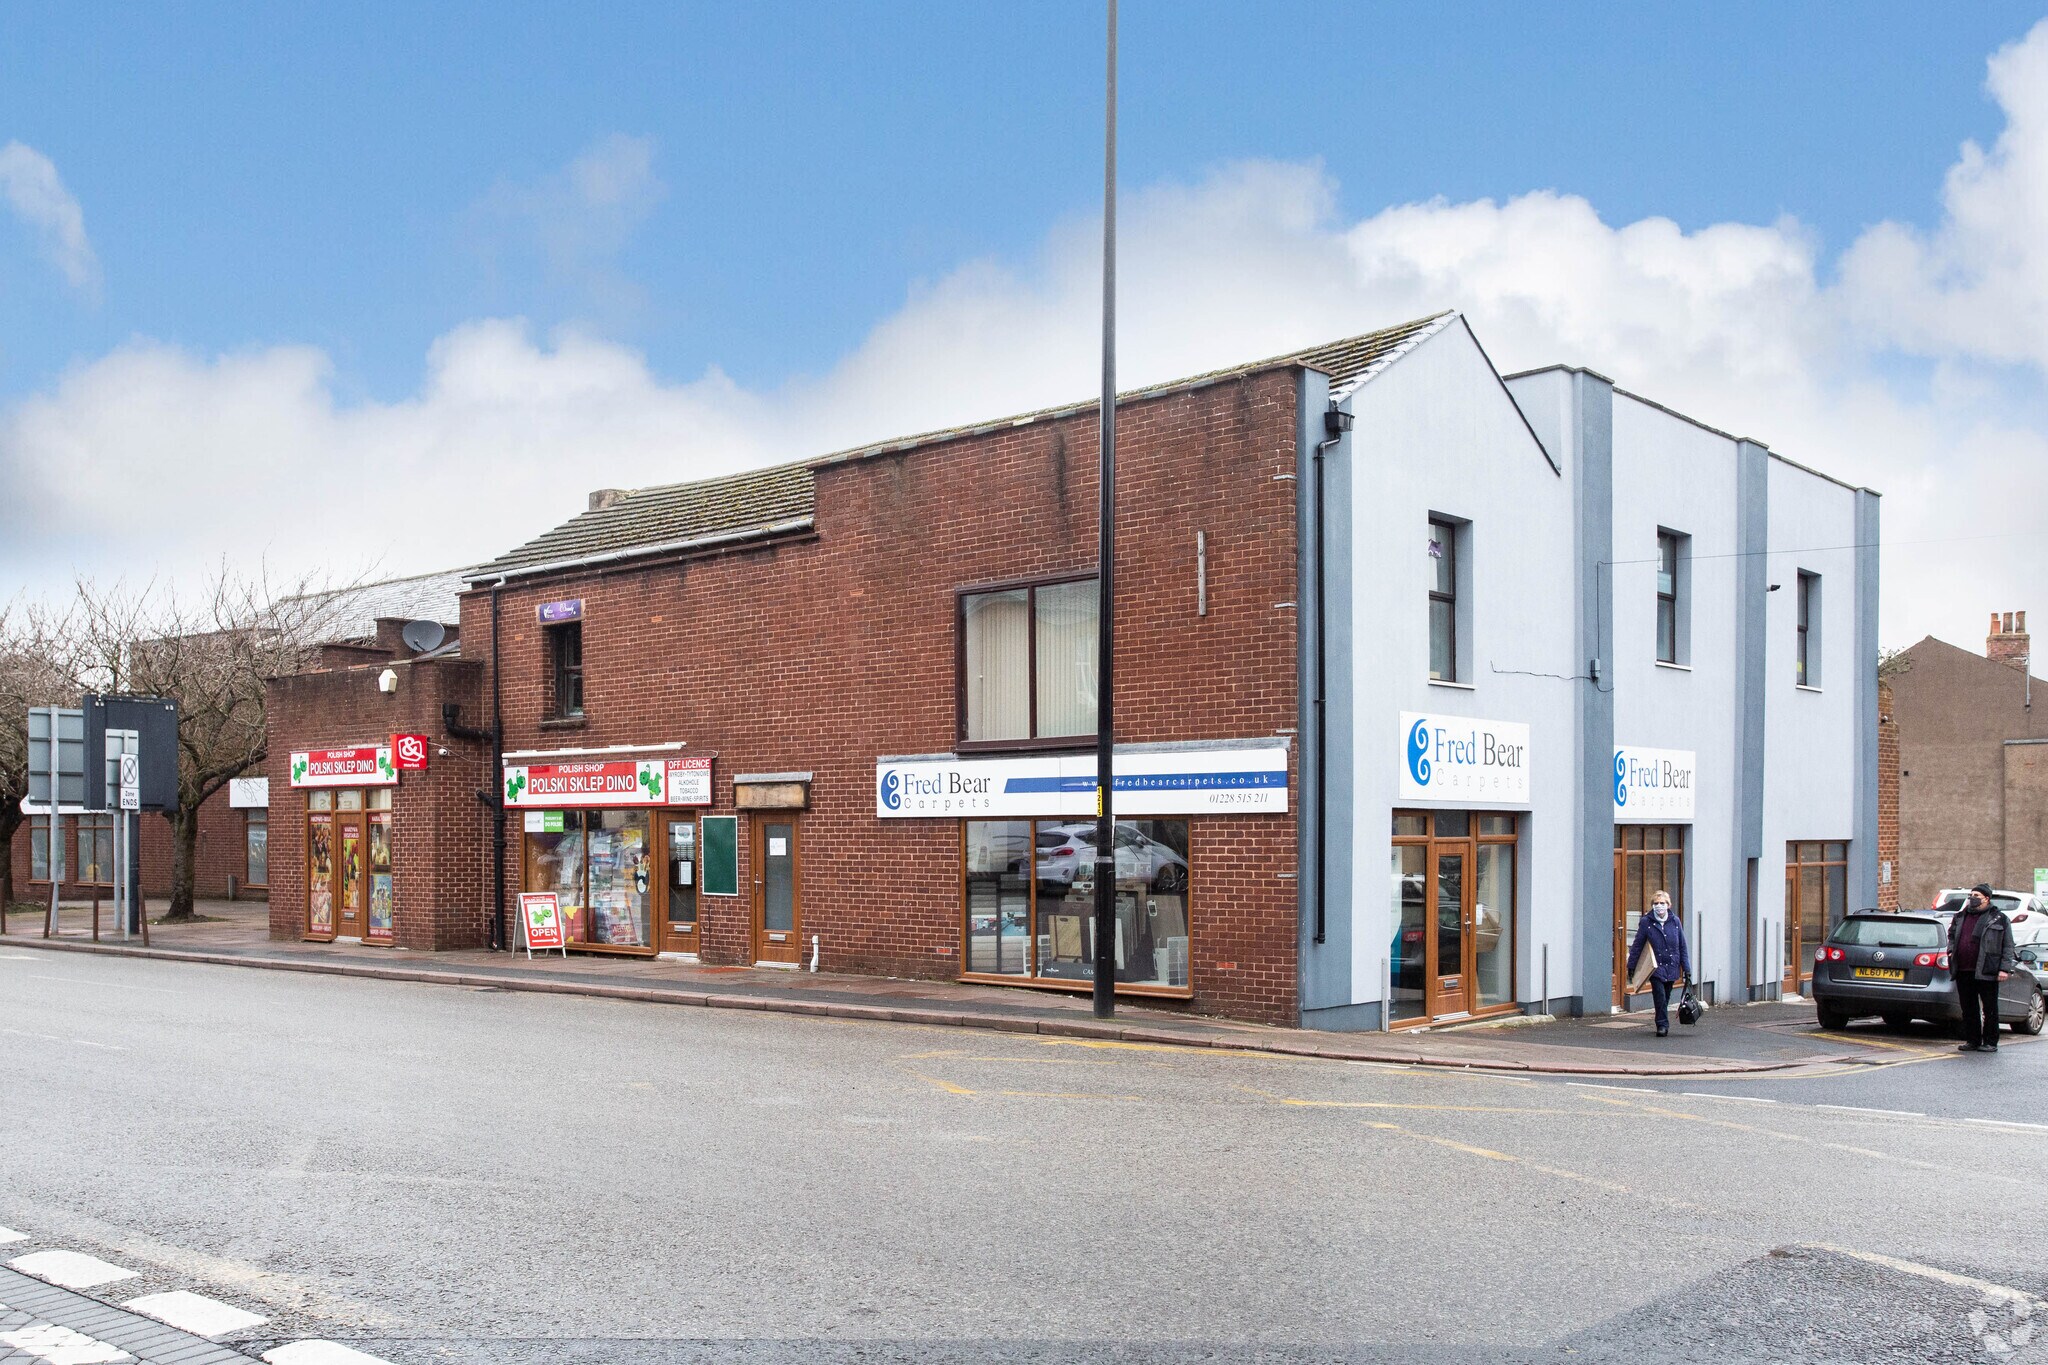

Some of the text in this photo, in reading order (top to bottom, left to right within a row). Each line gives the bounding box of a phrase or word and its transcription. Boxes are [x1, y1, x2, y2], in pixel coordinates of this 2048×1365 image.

[1434, 728, 1523, 768] Fred Bear
[310, 759, 374, 775] POLSKI SKLEP DINO
[558, 764, 604, 773] POLISH SHOP
[668, 759, 710, 769] OFF LICENCE
[1436, 768, 1525, 792] Carpets
[1629, 757, 1691, 788] Fred Bear
[531, 774, 634, 793] POLSKI SKLEP DINO
[904, 772, 990, 795] Fred Bear
[122, 798, 138, 806] ENDS
[904, 797, 990, 811] Carpets
[1209, 793, 1269, 804] 01228 515 211
[1631, 791, 1690, 810] Carpets
[531, 928, 557, 936] OPEN
